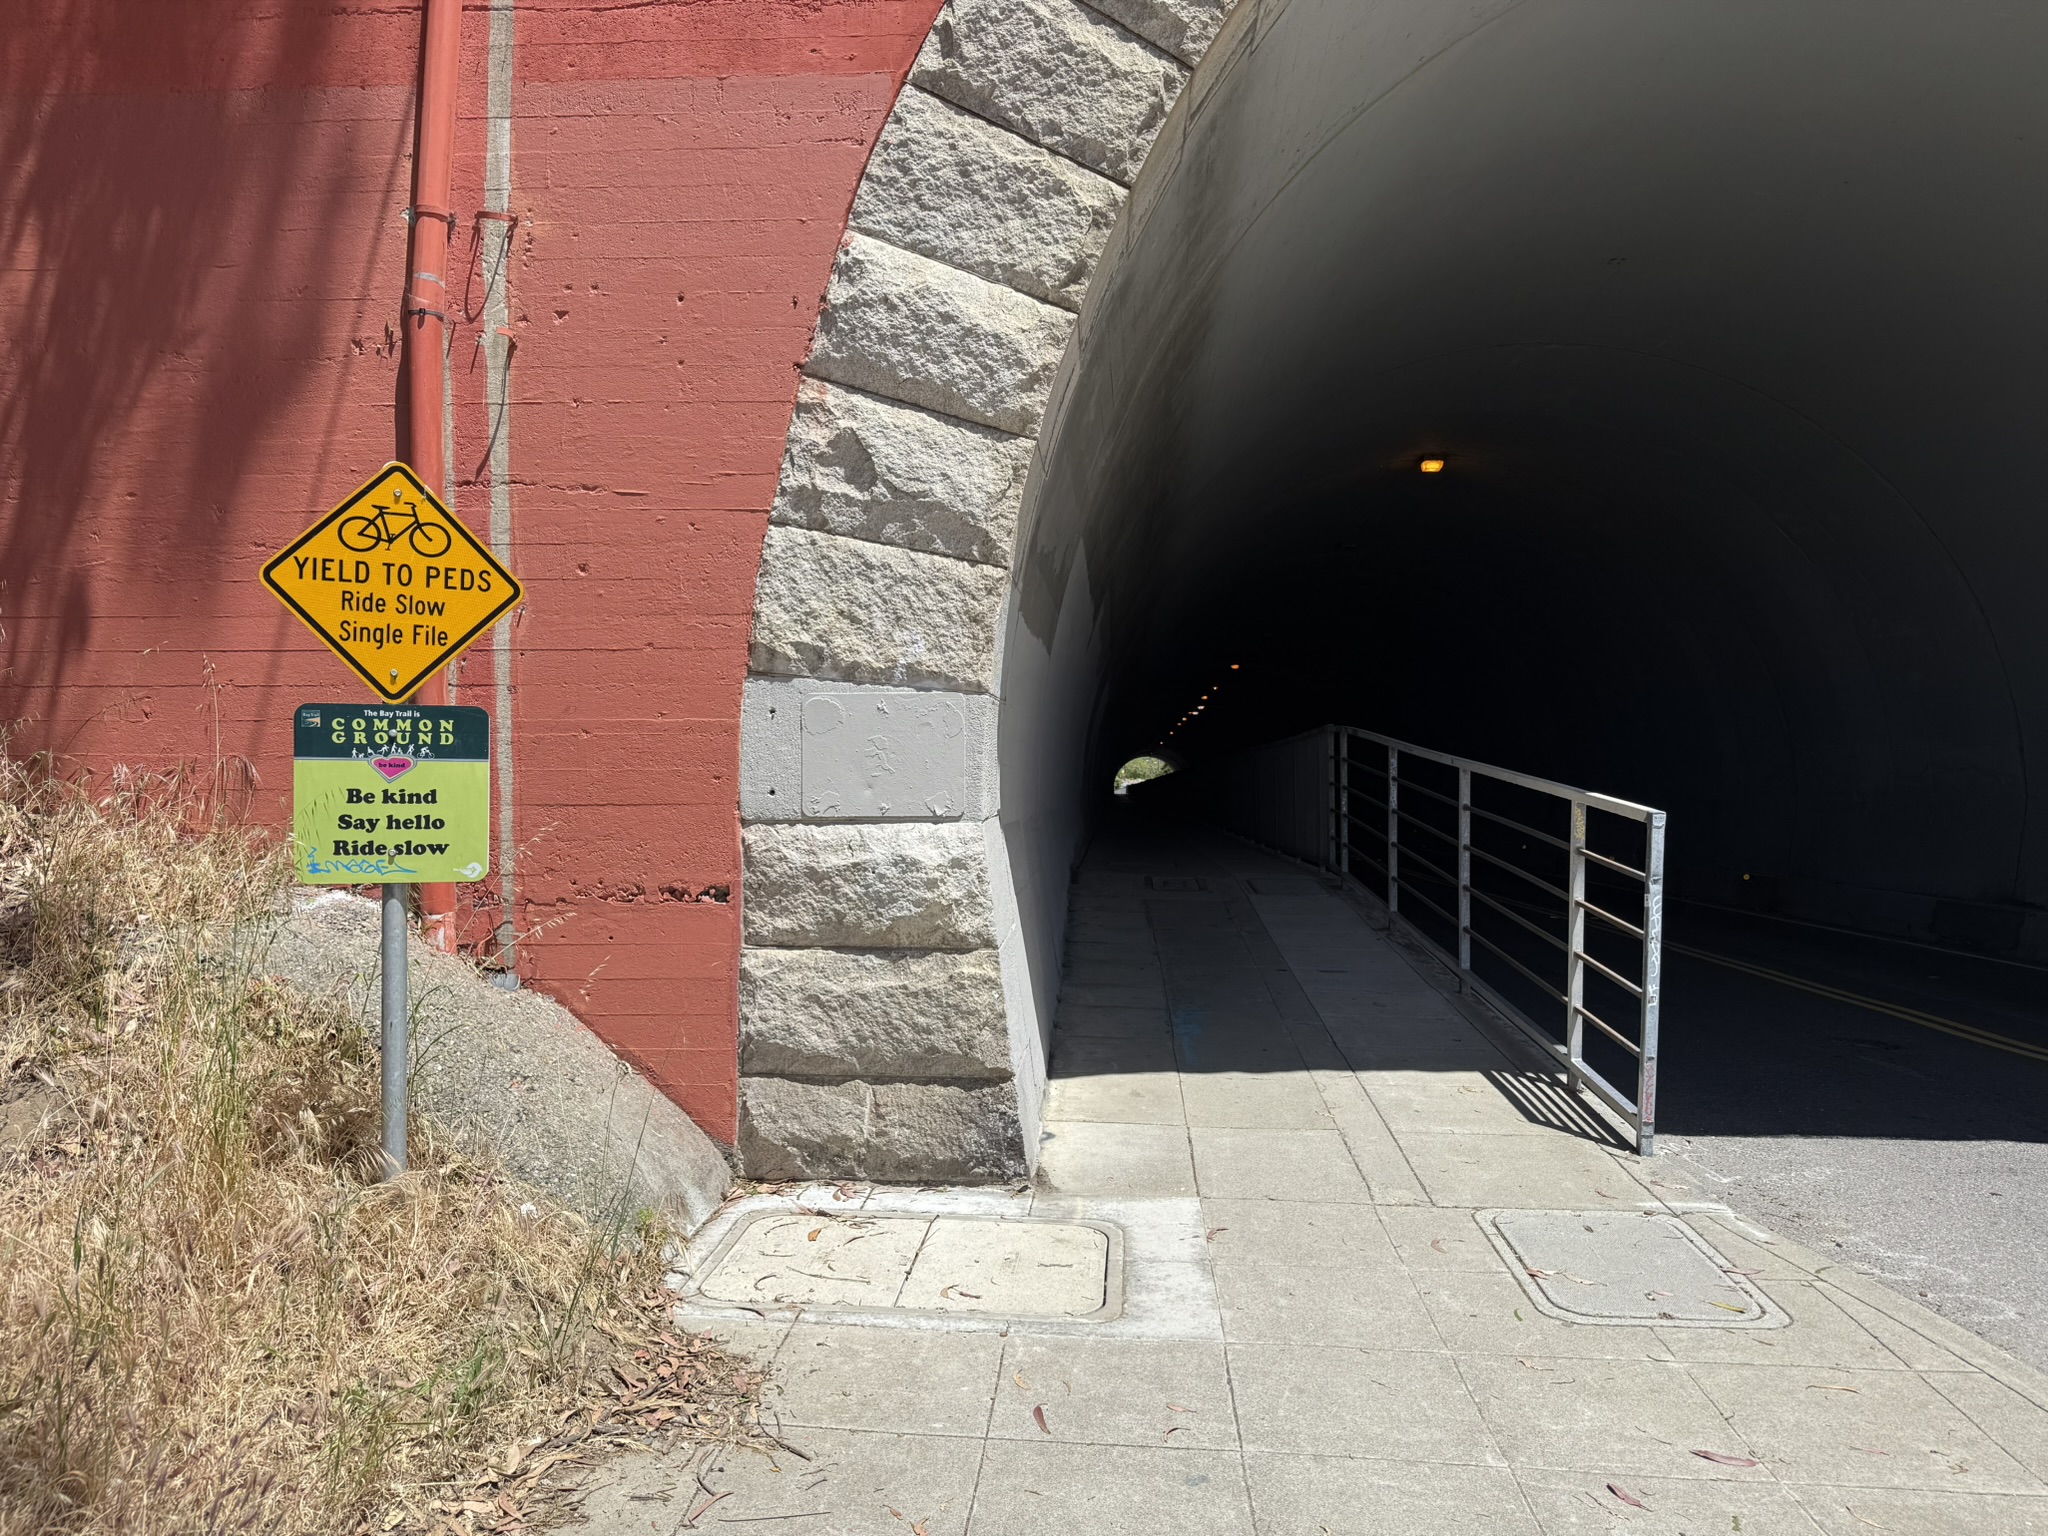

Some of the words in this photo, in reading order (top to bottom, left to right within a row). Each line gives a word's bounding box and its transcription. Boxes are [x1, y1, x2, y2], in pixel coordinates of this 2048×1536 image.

[293, 556, 370, 584] YIELD
[383, 562, 413, 587] TO
[425, 566, 492, 592] PEDS
[341, 590, 386, 613] Ride
[395, 594, 446, 616] Slow
[339, 620, 403, 650] Single
[412, 624, 448, 646] File
[363, 709, 378, 717] The
[379, 710, 394, 719] Bay
[413, 710, 421, 718] is
[331, 718, 454, 732] COMMON
[331, 731, 454, 745] GROUND
[345, 788, 376, 804] Be
[381, 788, 438, 804] kind
[337, 814, 380, 833] Say
[385, 814, 445, 830] hello
[332, 840, 388, 856] Ride
[393, 840, 450, 856] slow
